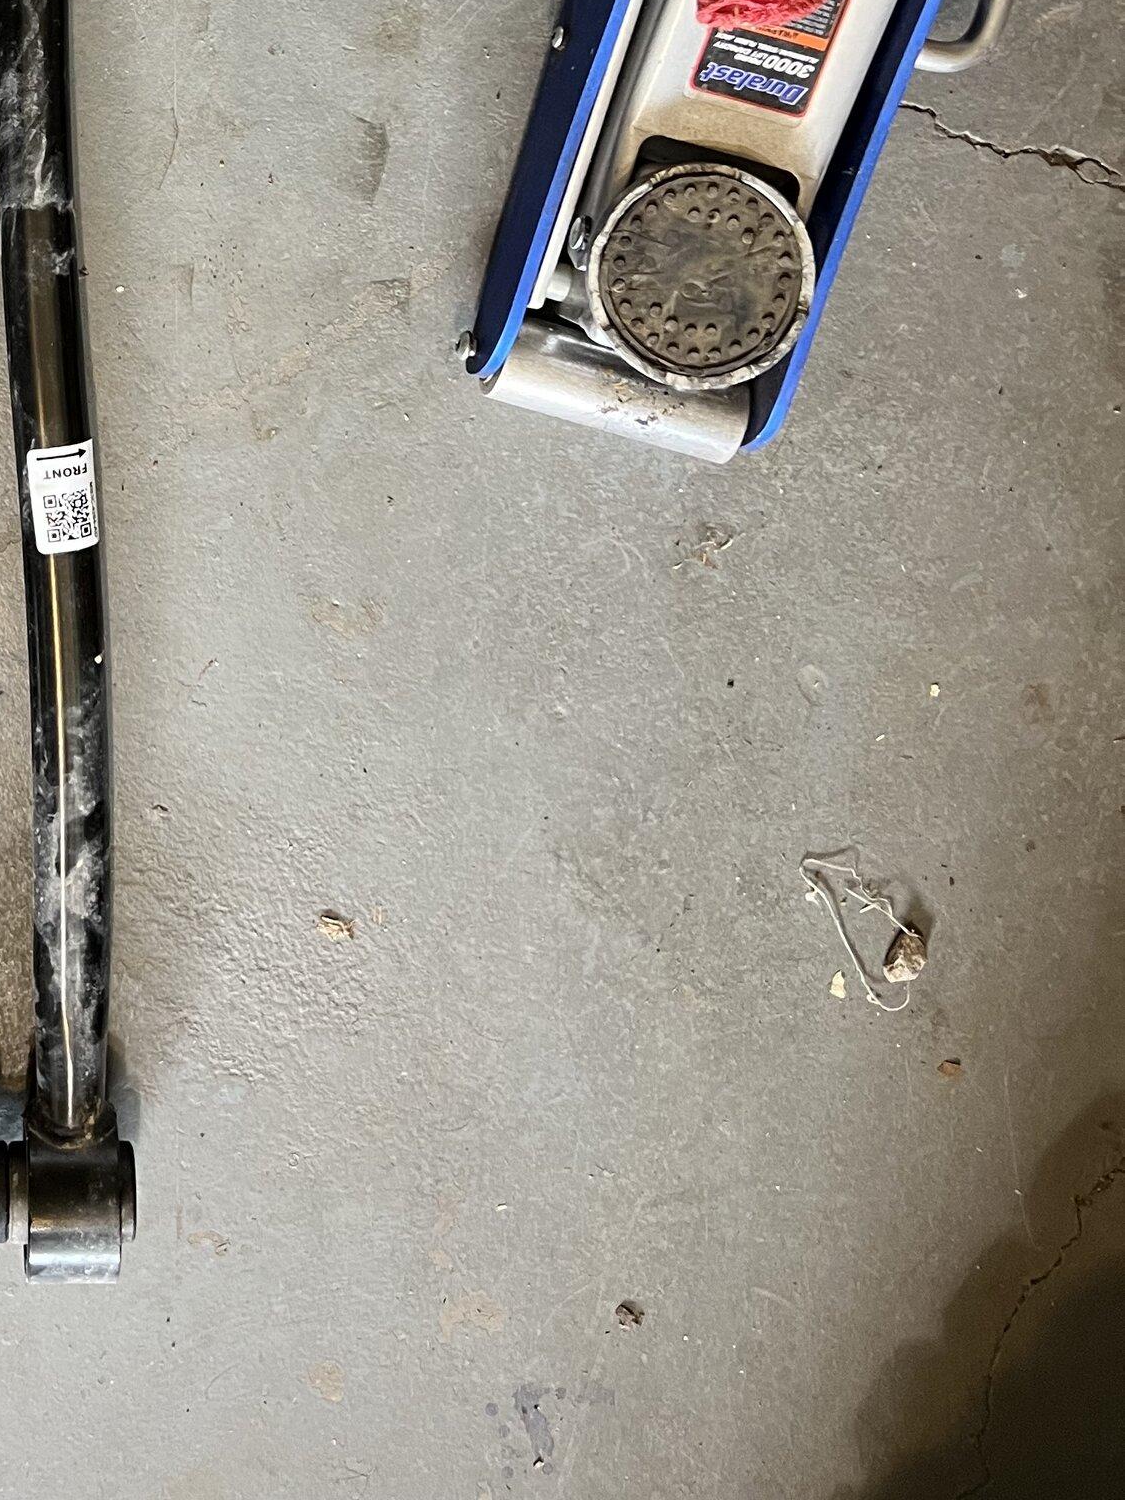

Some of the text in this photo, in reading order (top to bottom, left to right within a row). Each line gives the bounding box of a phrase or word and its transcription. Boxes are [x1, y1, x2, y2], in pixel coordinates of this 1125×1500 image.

[762, 54, 815, 78] 3000
[699, 62, 809, 105] Duralast
[44, 463, 88, 479] FRONT
